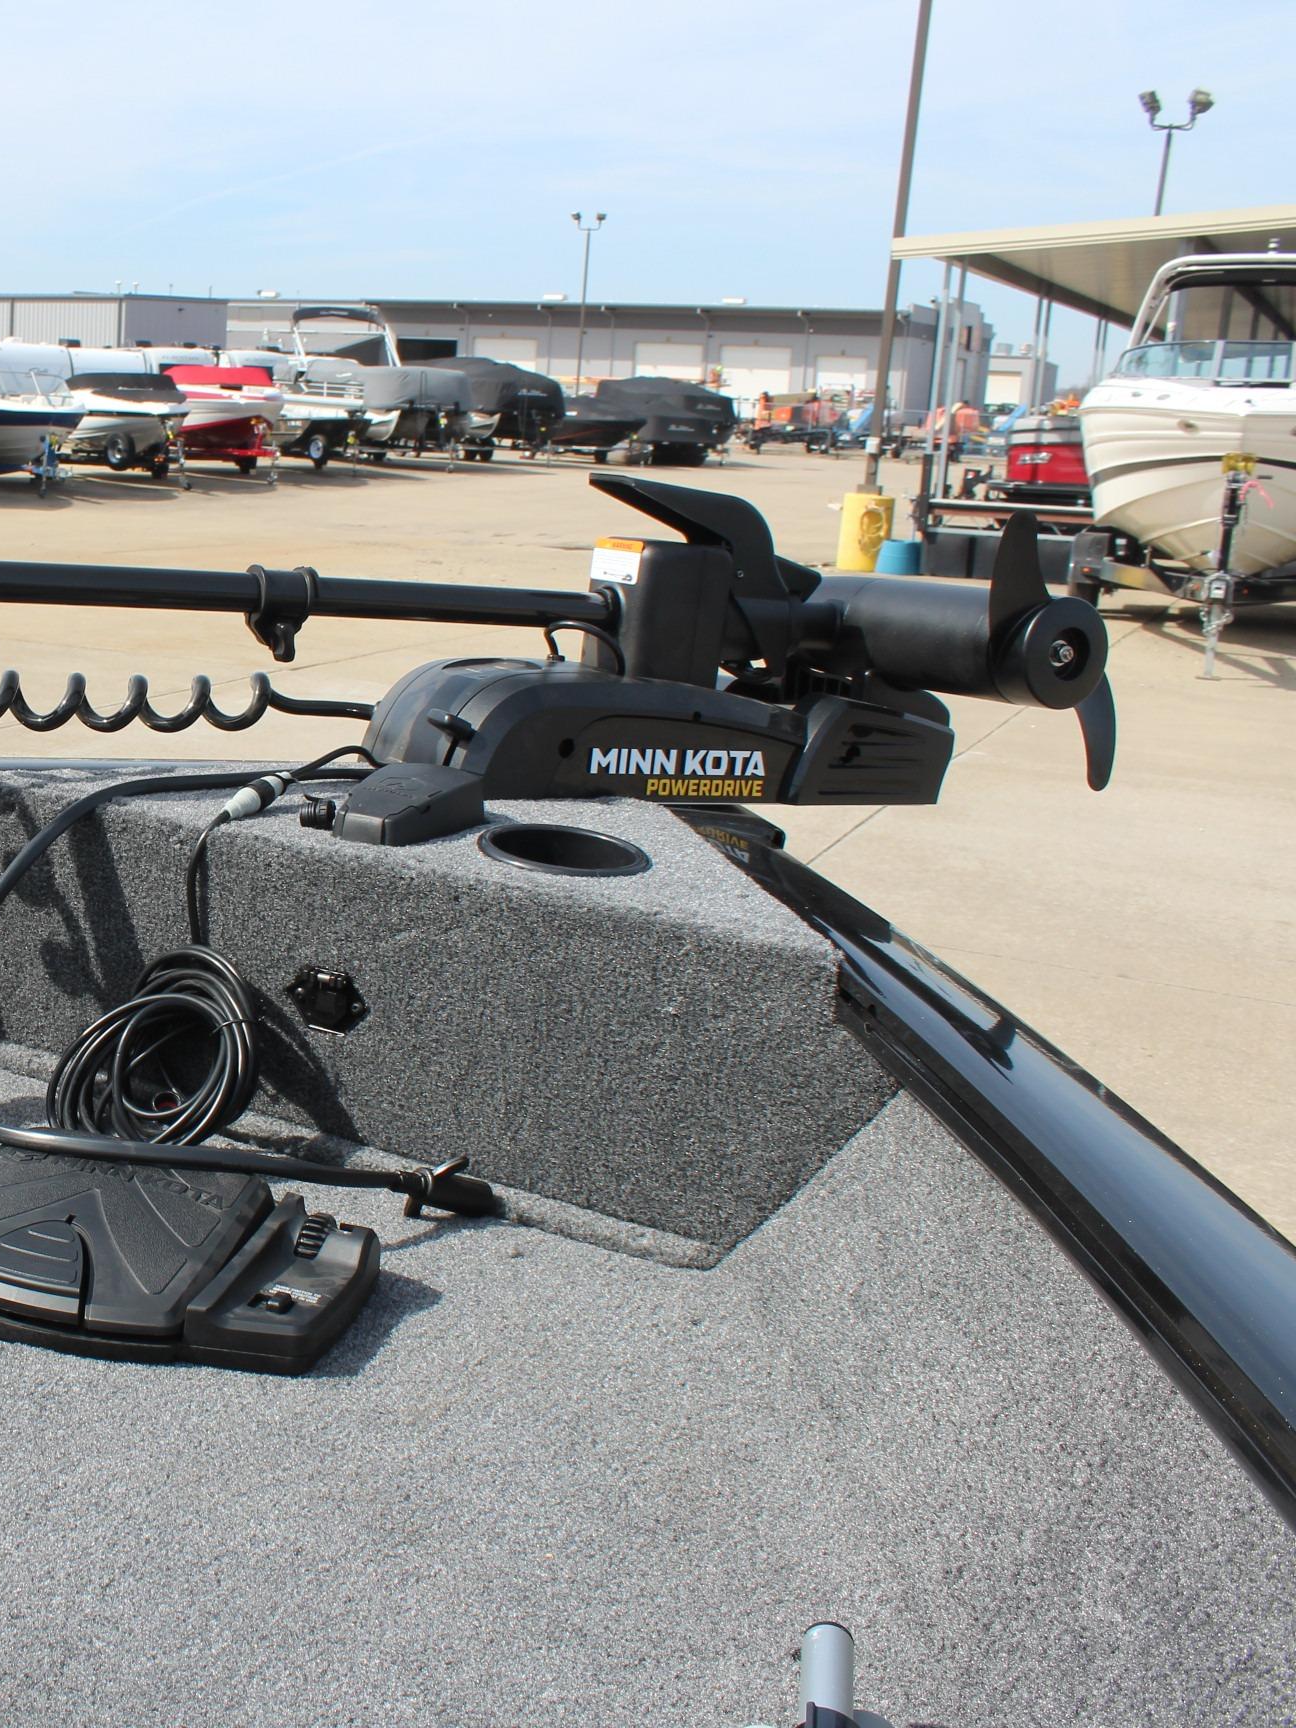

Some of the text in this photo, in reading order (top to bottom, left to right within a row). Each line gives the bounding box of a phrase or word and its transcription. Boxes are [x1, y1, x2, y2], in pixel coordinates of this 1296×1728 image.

[589, 747, 766, 777] MINN KOTA
[646, 778, 764, 797] POWERDRIVE
